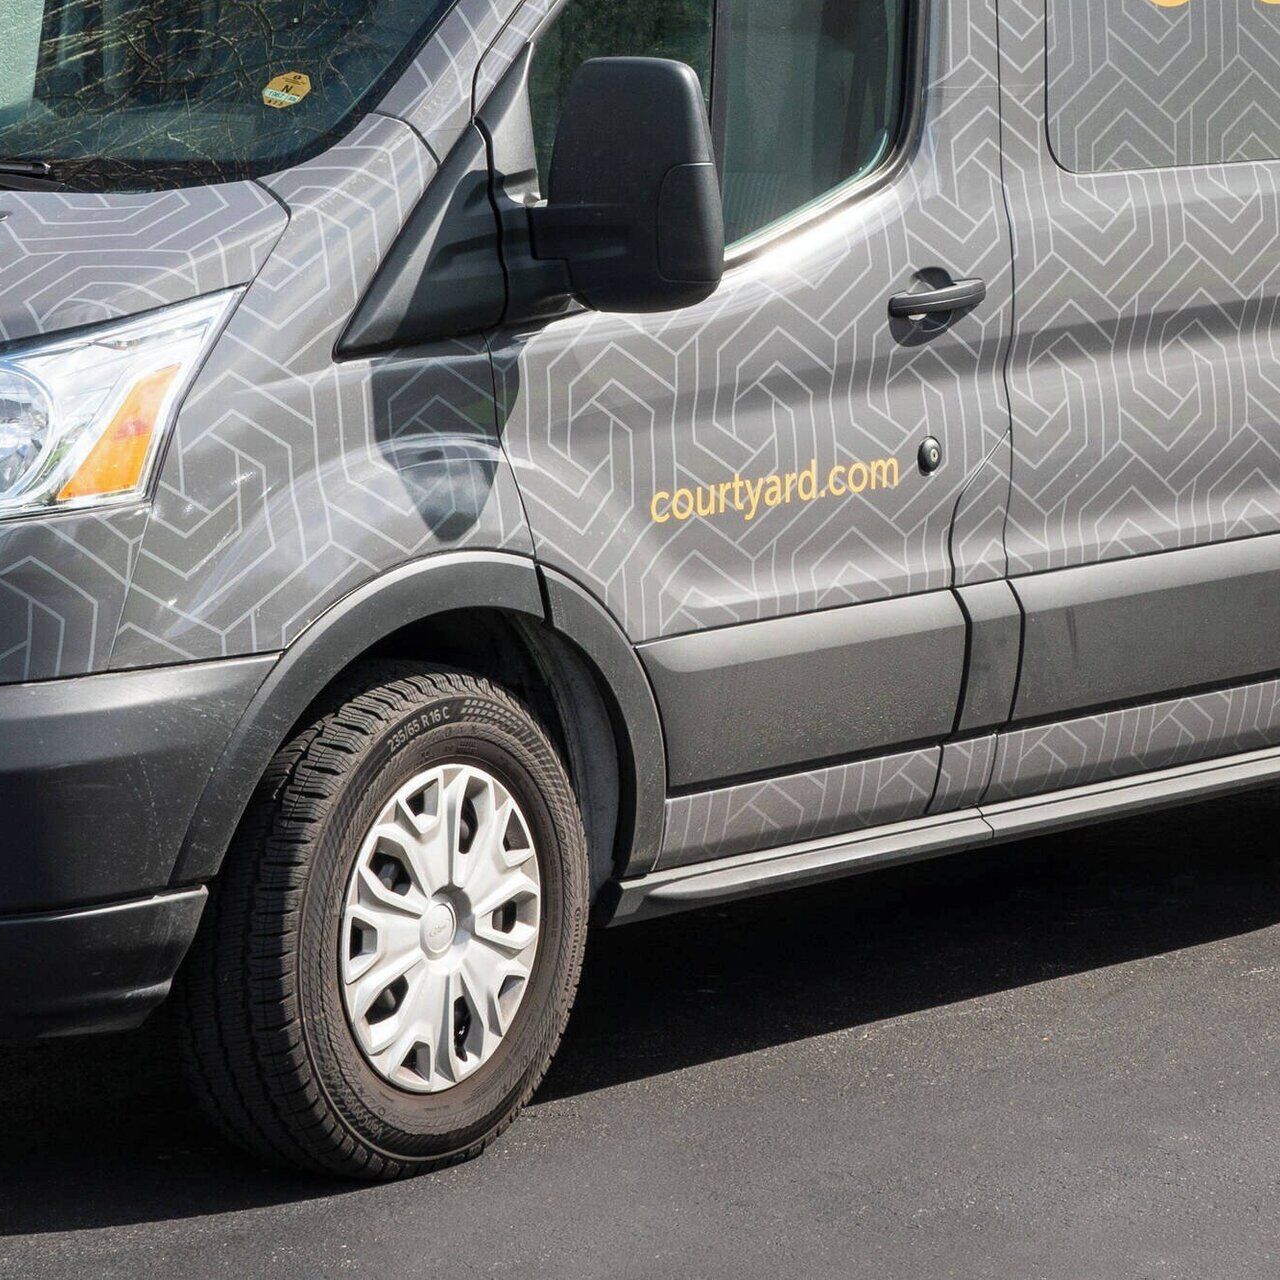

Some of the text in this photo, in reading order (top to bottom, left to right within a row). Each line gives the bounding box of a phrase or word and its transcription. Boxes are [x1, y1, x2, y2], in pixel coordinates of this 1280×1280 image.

[650, 457, 900, 523] courtyard.com
[387, 719, 421, 753] 235/65
[421, 713, 430, 728] R
[430, 708, 441, 724] 16
[442, 706, 451, 720] C
